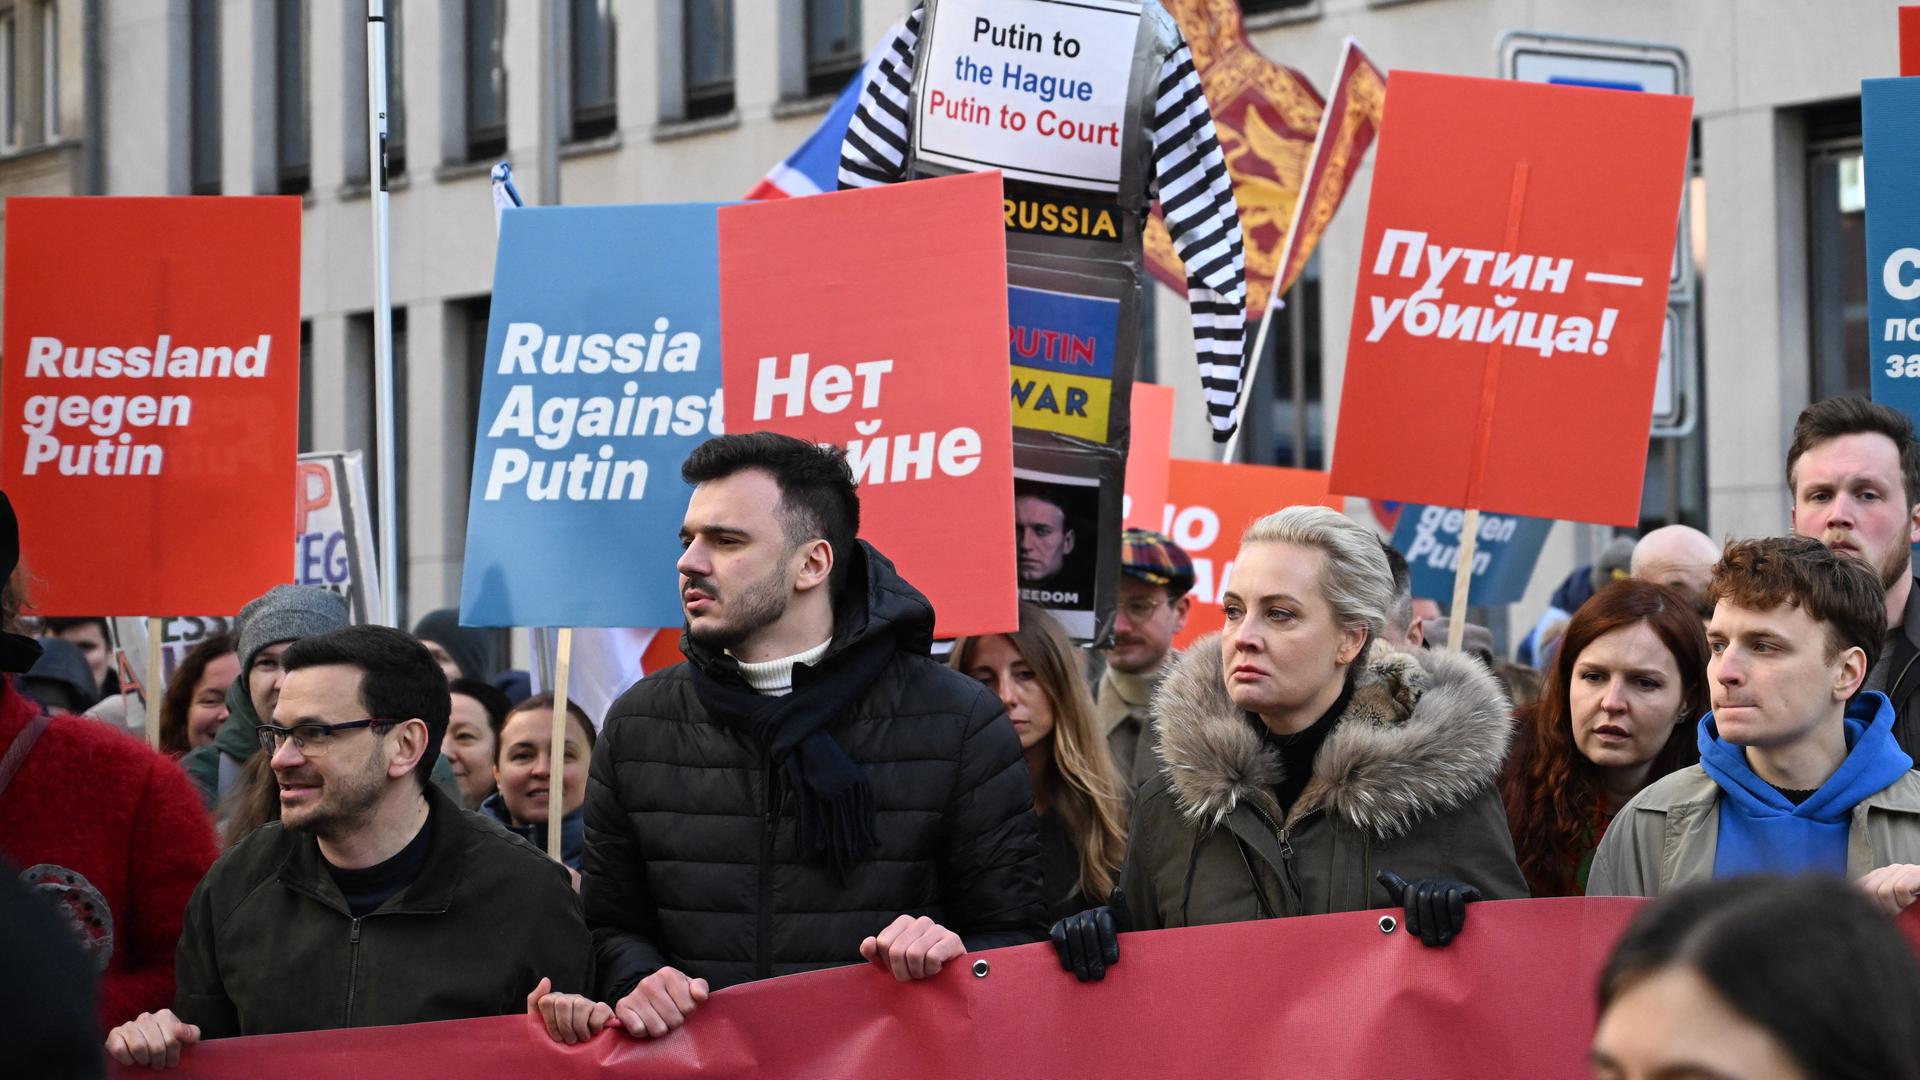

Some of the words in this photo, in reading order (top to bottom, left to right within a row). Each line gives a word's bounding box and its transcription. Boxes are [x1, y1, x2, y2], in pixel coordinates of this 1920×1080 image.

[973, 16, 1043, 53] Putin
[1053, 31, 1081, 58] to
[955, 55, 993, 86] the
[1002, 62, 1093, 103] Hague
[929, 90, 991, 126] Putin
[1000, 104, 1026, 131] to
[1037, 109, 1119, 147] Court
[1003, 199, 1117, 238] RUSSIA
[1372, 228, 1574, 294] Путин
[497, 317, 701, 374] Russia
[1365, 287, 1620, 358] убийца!
[25, 335, 271, 378] Russland
[753, 352, 893, 421] Нет
[1011, 378, 1088, 418] WAR
[21, 394, 192, 437] gegen
[487, 380, 725, 450] Against
[22, 432, 163, 476] Putin
[484, 444, 648, 501] Putin
[815, 419, 981, 485] йне
[1416, 505, 1517, 542] geen
[1406, 528, 1491, 575] Pun
[1018, 588, 1079, 604] EEDOM
